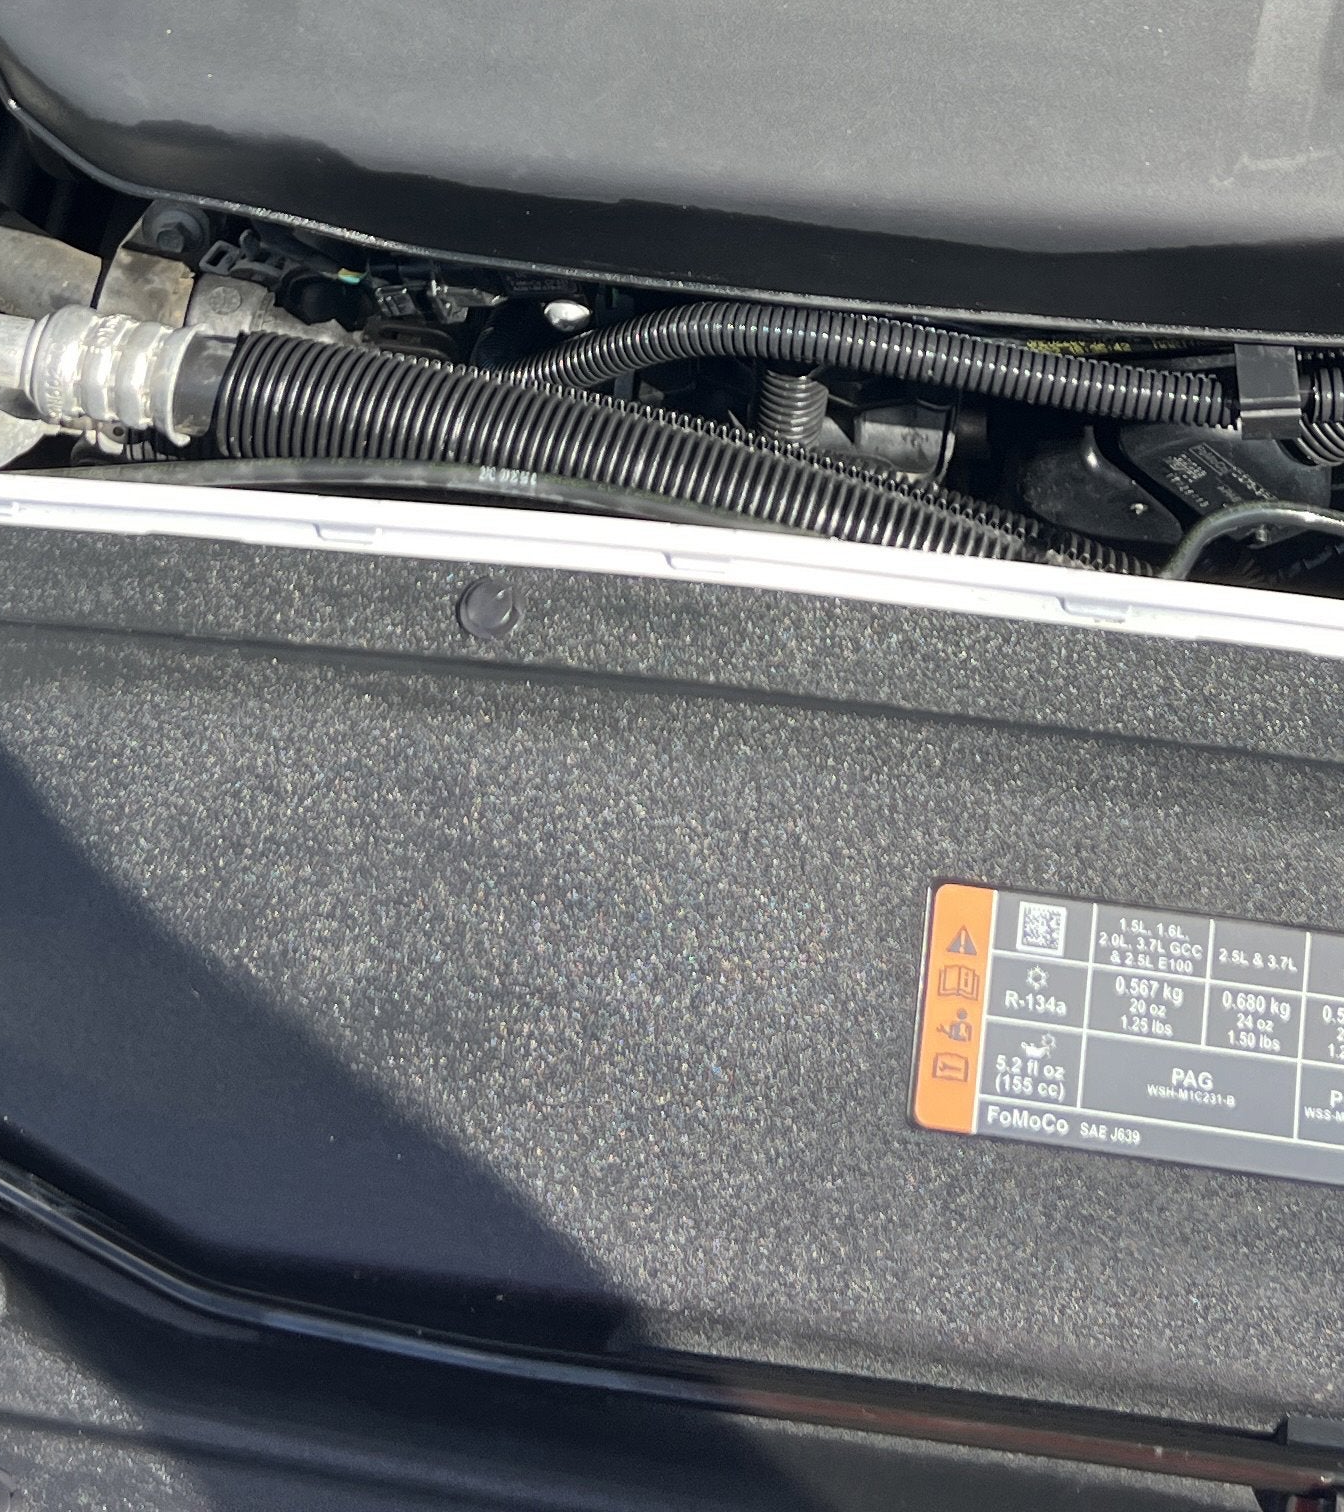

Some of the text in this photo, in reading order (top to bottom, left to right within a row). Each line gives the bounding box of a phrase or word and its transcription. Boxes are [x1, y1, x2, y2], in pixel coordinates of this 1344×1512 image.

[1136, 937, 1166, 954] 3.7L
[1169, 941, 1203, 960] GCC
[1218, 947, 1298, 974] 2.5L & 3.7L
[1110, 950, 1193, 975] & 2.5L E100
[1004, 989, 1068, 1017] R-134a
[1115, 975, 1185, 1007] 0.567 kg
[1129, 998, 1167, 1019] 20 oz
[1222, 990, 1291, 1022] 0.680 kg
[1120, 1014, 1174, 1037] 1.25 lbs
[1236, 1012, 1274, 1033] 24 oz
[1227, 1029, 1281, 1053] 1.50 lbs
[995, 1054, 1066, 1082] 5.2 fl oz
[1171, 1067, 1214, 1091] PAG
[995, 1073, 1067, 1102] (155 cc)
[1146, 1083, 1236, 1109] WSH-M1C231-B
[986, 1105, 1142, 1146] FoMoCo SAE J639
